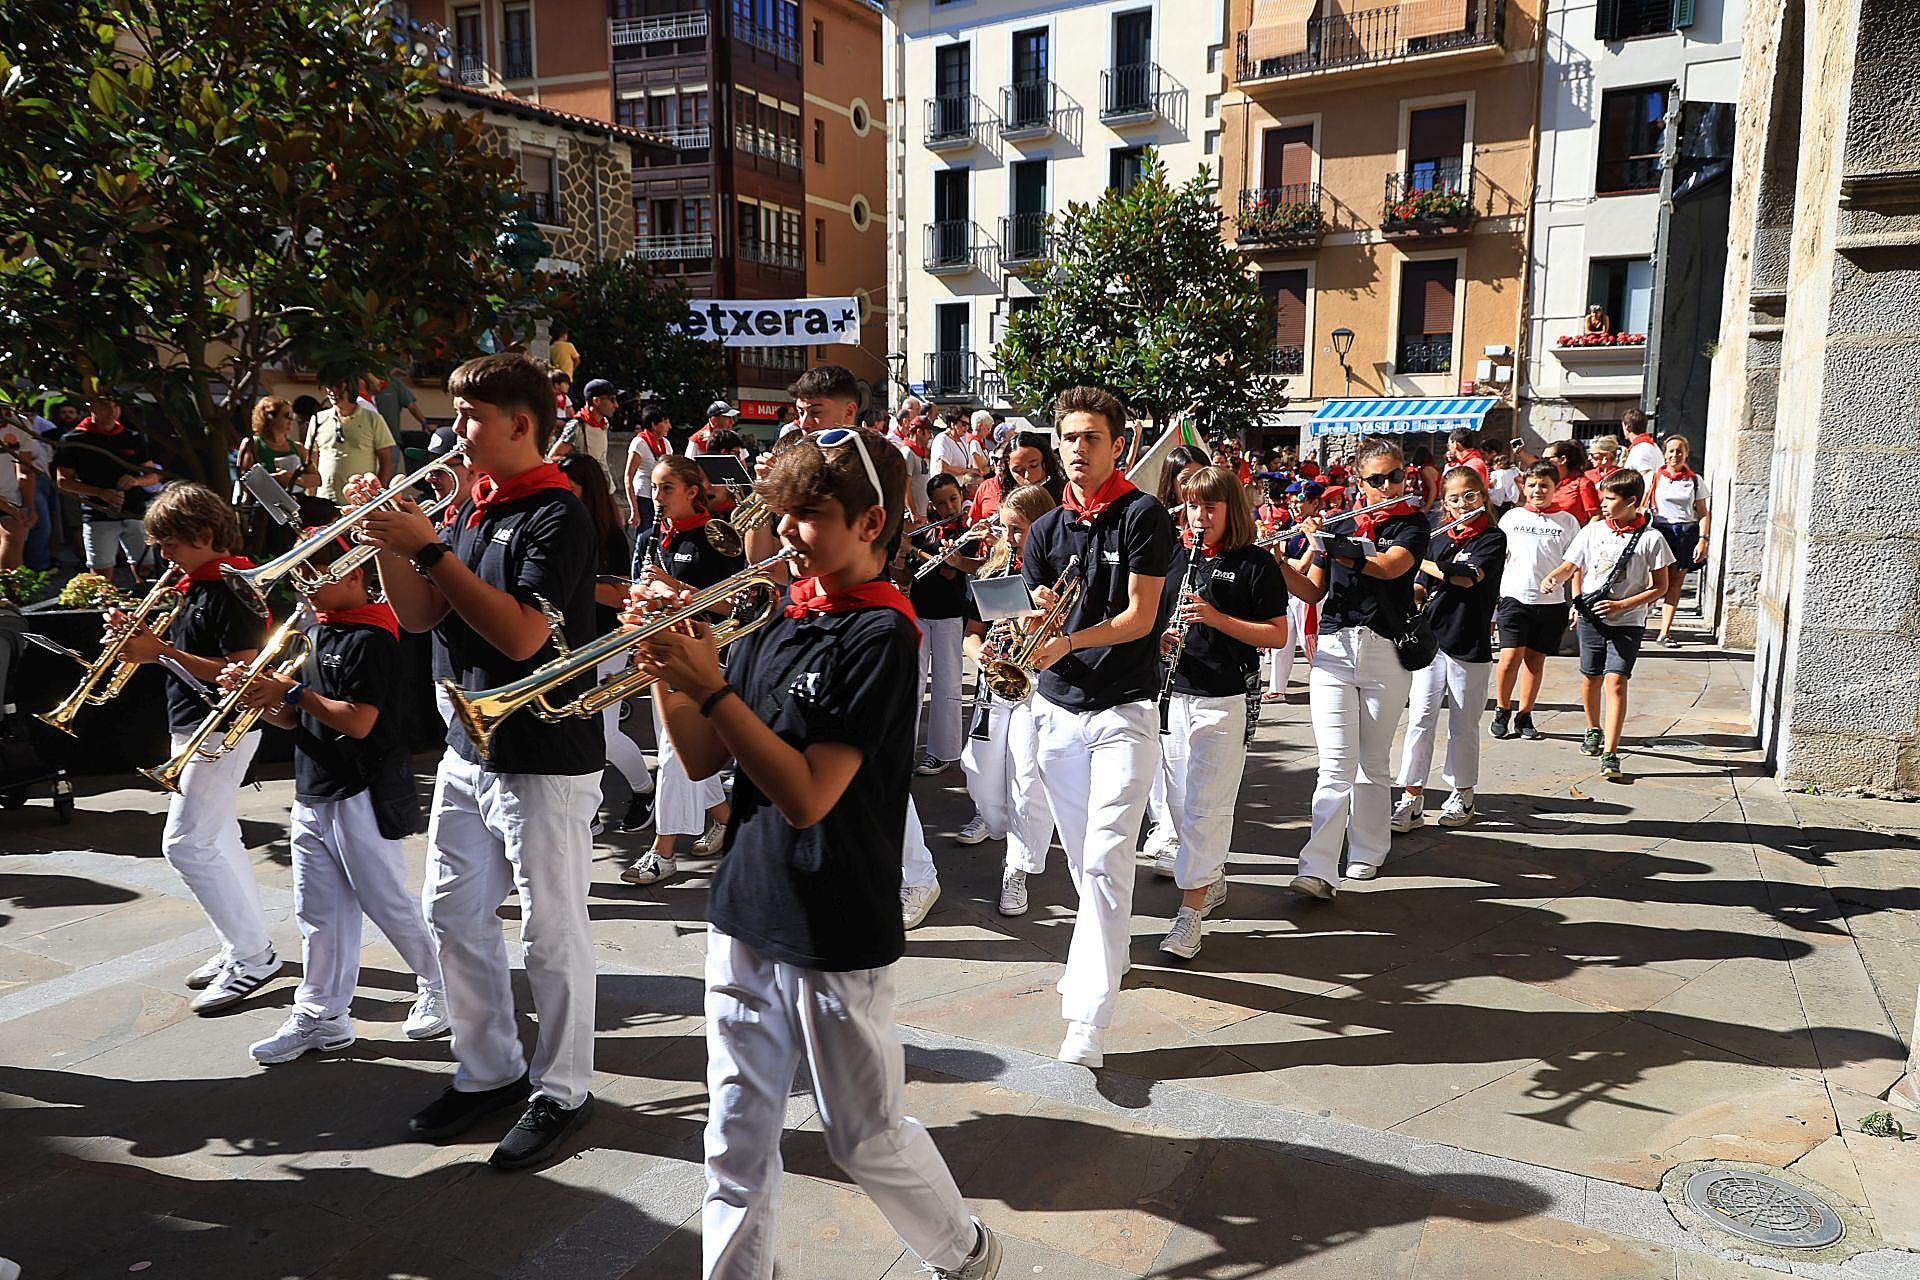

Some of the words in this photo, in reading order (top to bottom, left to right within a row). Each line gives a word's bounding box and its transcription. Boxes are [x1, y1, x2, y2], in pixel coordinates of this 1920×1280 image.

[687, 303, 829, 337] etxera
[1513, 525, 1536, 533] WAVE
[1540, 527, 1563, 536] SPOT
